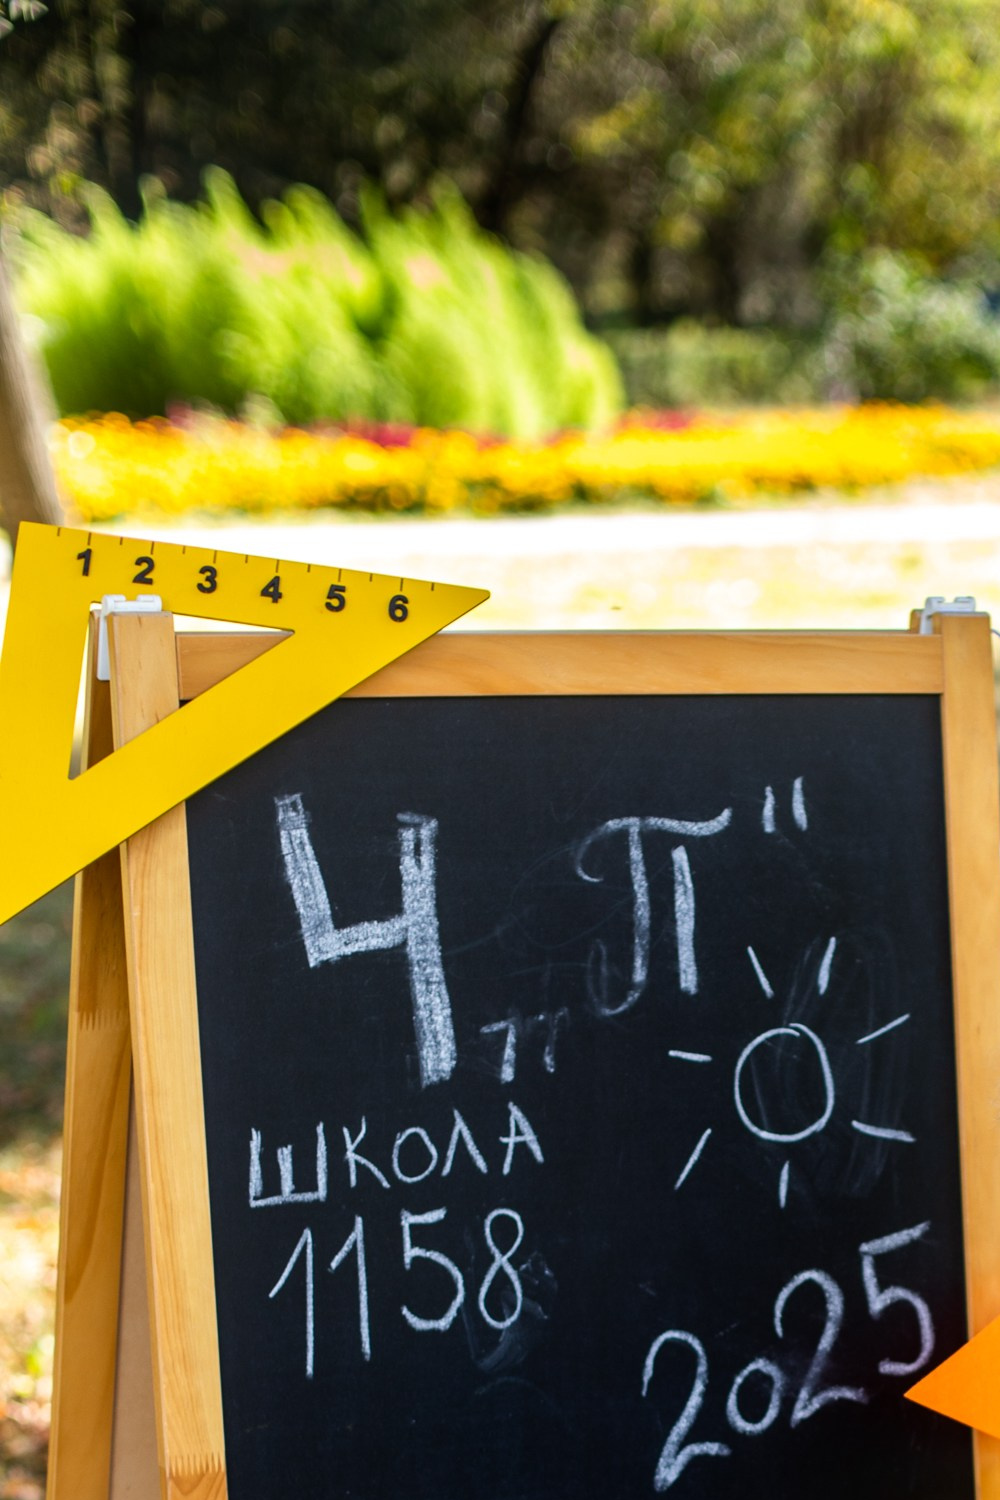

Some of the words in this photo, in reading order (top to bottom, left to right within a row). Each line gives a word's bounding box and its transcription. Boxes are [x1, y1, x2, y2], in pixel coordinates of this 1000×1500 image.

[77, 548, 92, 577] 1
[132, 556, 155, 585] 2
[196, 565, 217, 594] 3
[260, 575, 283, 604] 4
[325, 584, 346, 613] 5
[388, 594, 409, 623] 6
[249, 1102, 544, 1207] ШКОЛА
[269, 1208, 524, 1379] 1158
[642, 1221, 936, 1491] 2025
